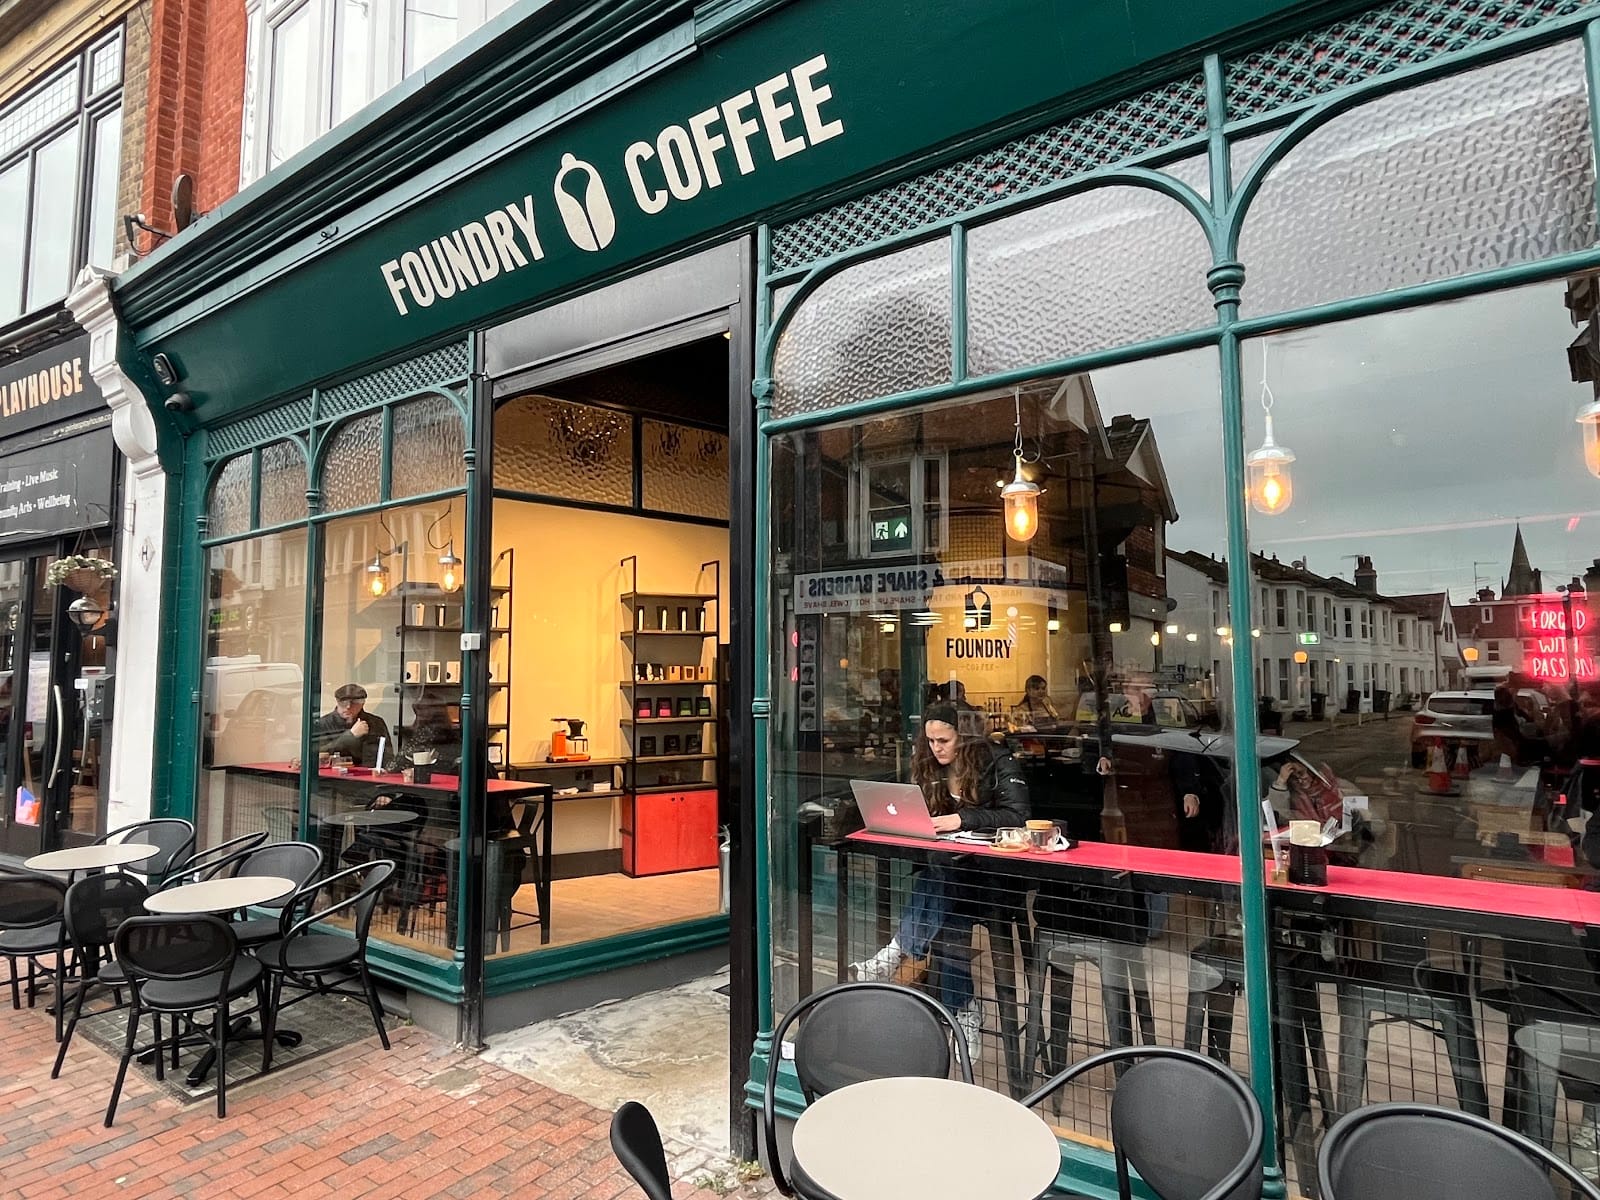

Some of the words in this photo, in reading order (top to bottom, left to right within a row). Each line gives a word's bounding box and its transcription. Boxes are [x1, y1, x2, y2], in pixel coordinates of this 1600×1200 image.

[380, 194, 545, 316] FOUNDRY
[624, 53, 844, 215] COFFEE
[0, 357, 83, 417] LAYHOUSE
[25, 474, 39, 486] Live
[40, 468, 58, 483] Music
[19, 500, 32, 514] Arts
[37, 494, 71, 510] Wellbeing
[1531, 610, 1586, 630] FORGD
[946, 637, 1012, 658] FOUNDRY
